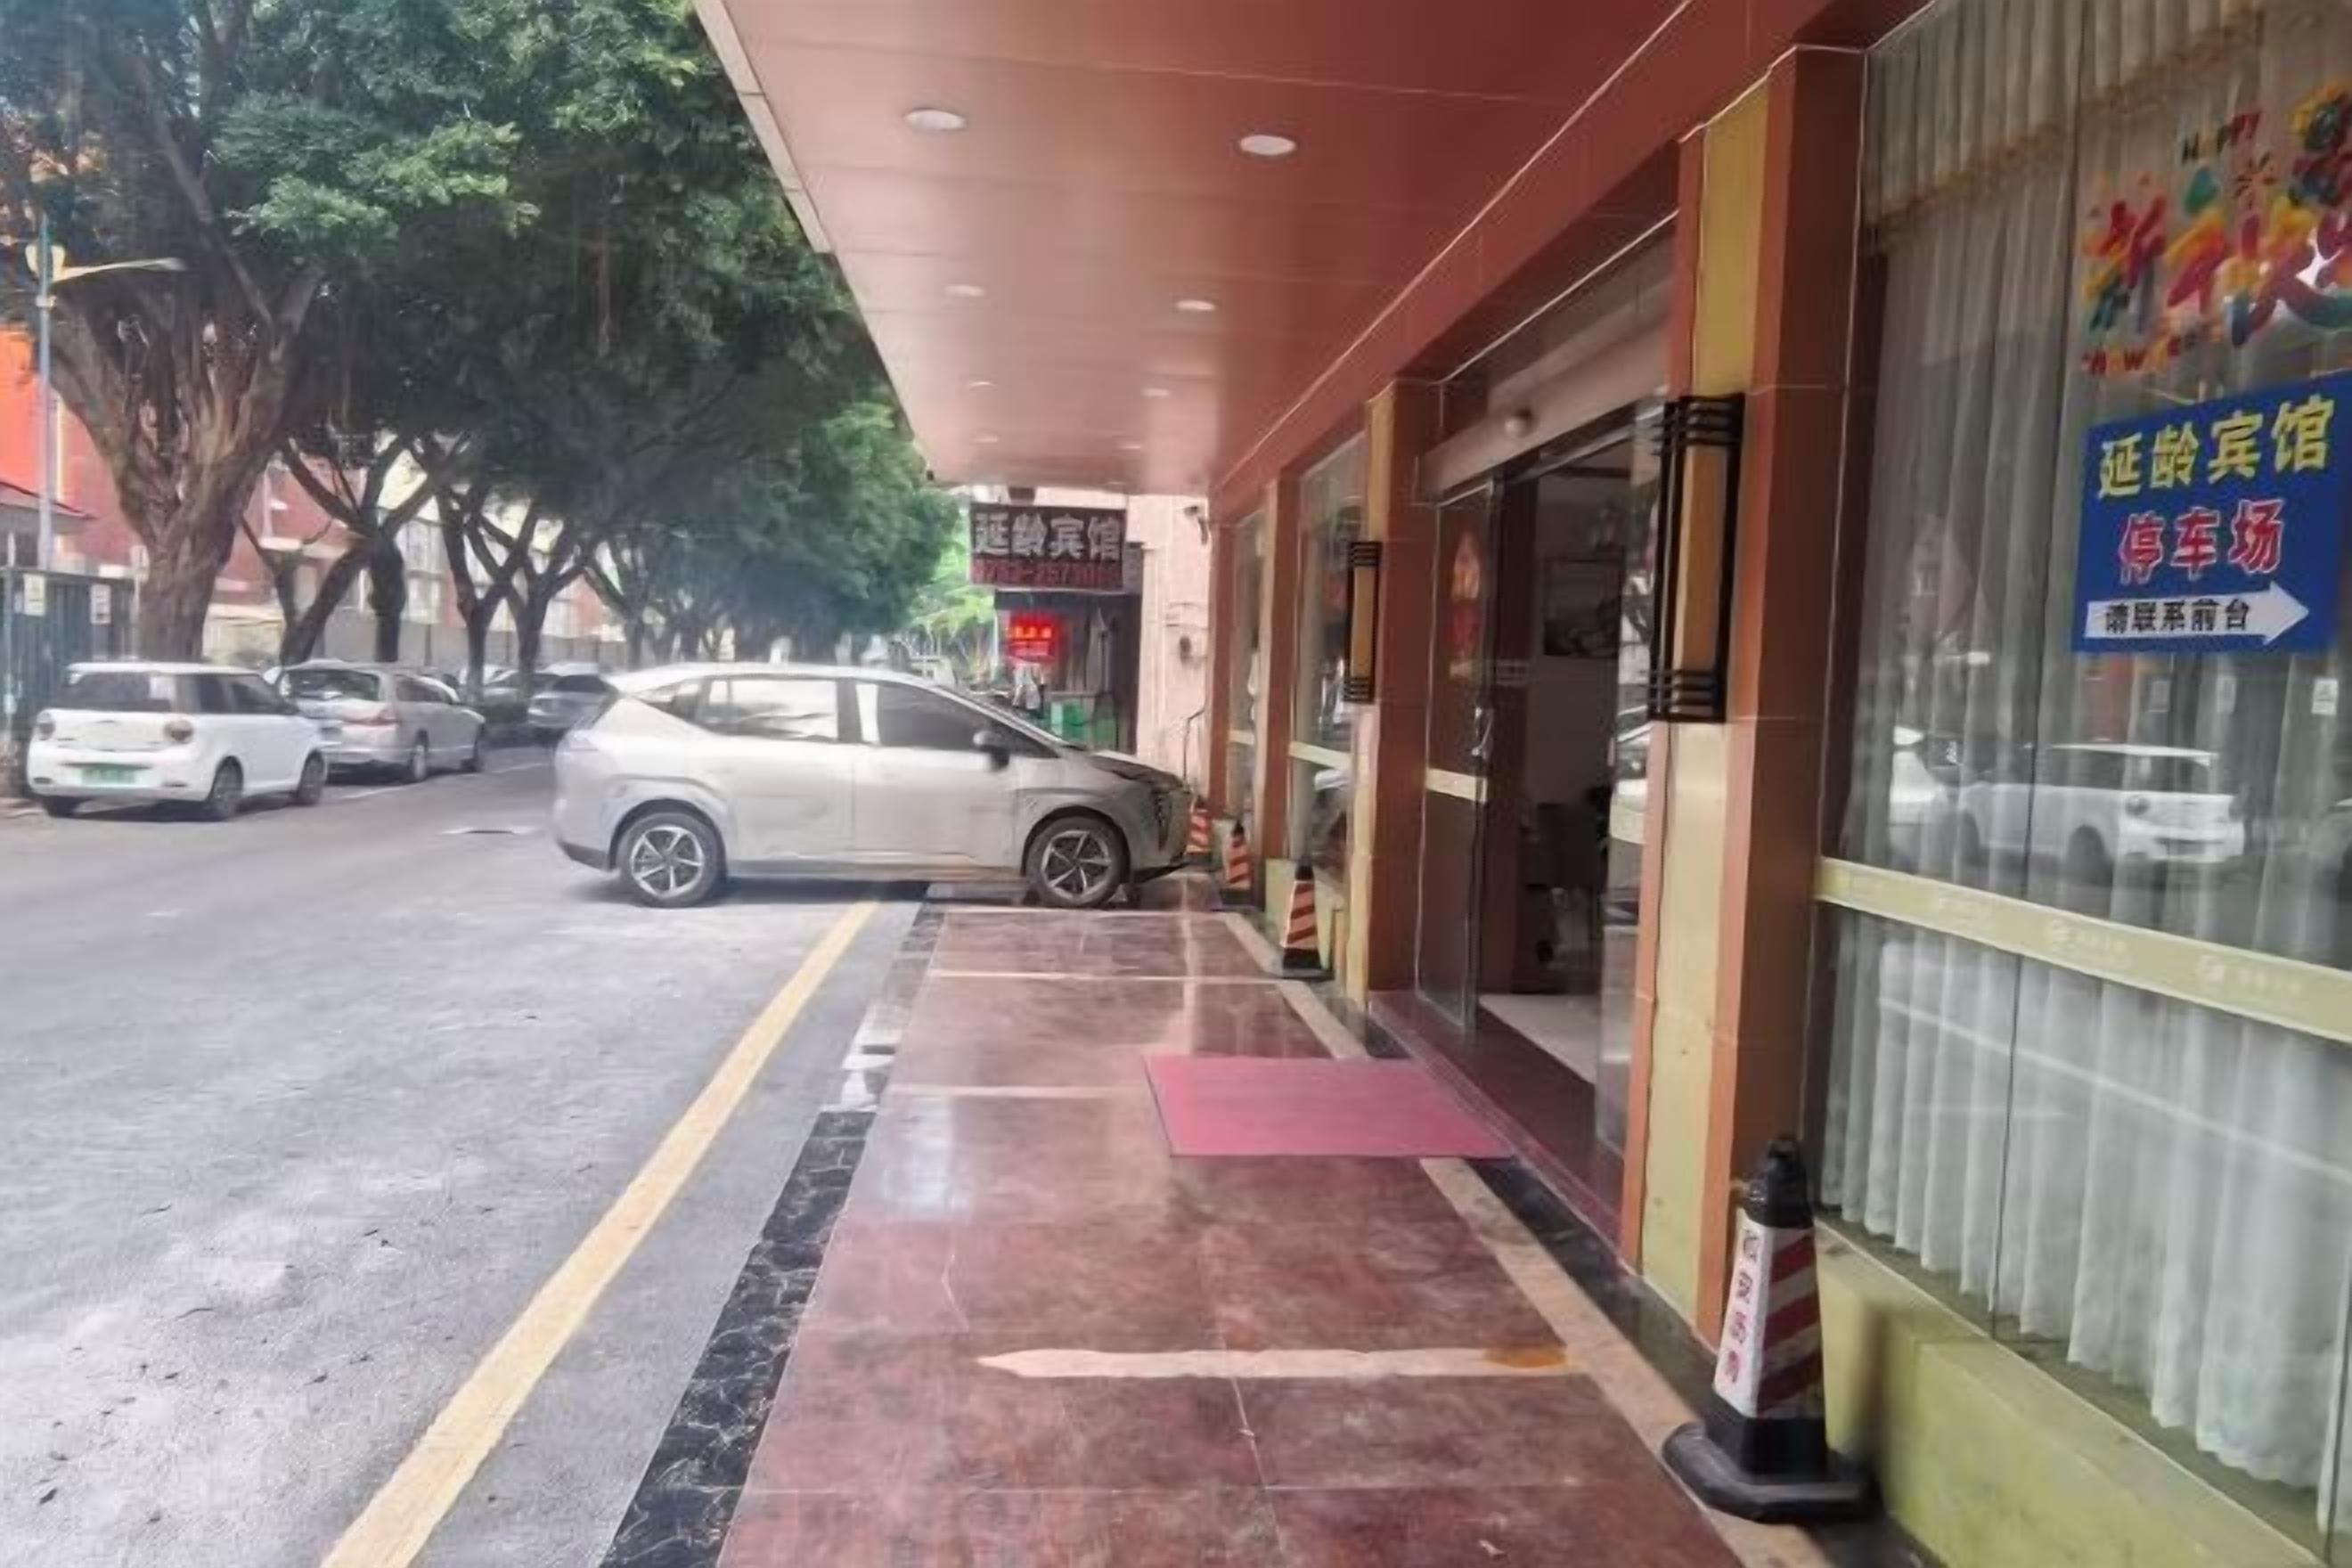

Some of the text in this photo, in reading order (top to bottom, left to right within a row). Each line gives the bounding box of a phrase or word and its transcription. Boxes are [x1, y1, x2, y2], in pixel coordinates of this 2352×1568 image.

[2099, 394, 2335, 499] 延龄宾馆
[2117, 499, 2284, 584] 停车场
[2105, 598, 2250, 634] 请联系前台
